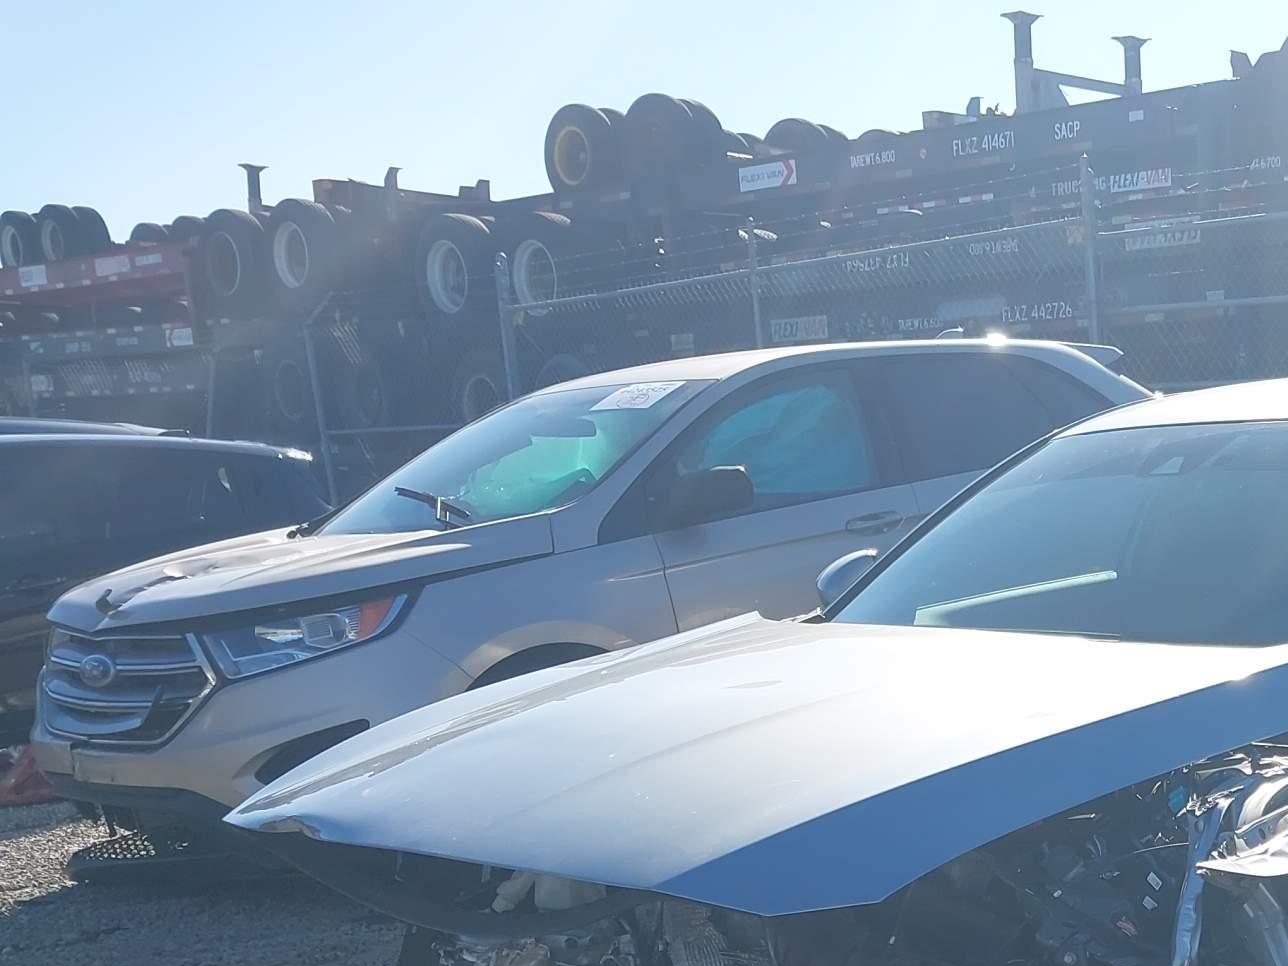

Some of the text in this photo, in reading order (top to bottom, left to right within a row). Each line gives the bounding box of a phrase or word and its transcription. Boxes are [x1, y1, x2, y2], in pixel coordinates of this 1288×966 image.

[1054, 121, 1081, 140] SACP
[952, 131, 1015, 157] FLXZ 414671
[1001, 302, 1073, 322] FLXZ 442726
